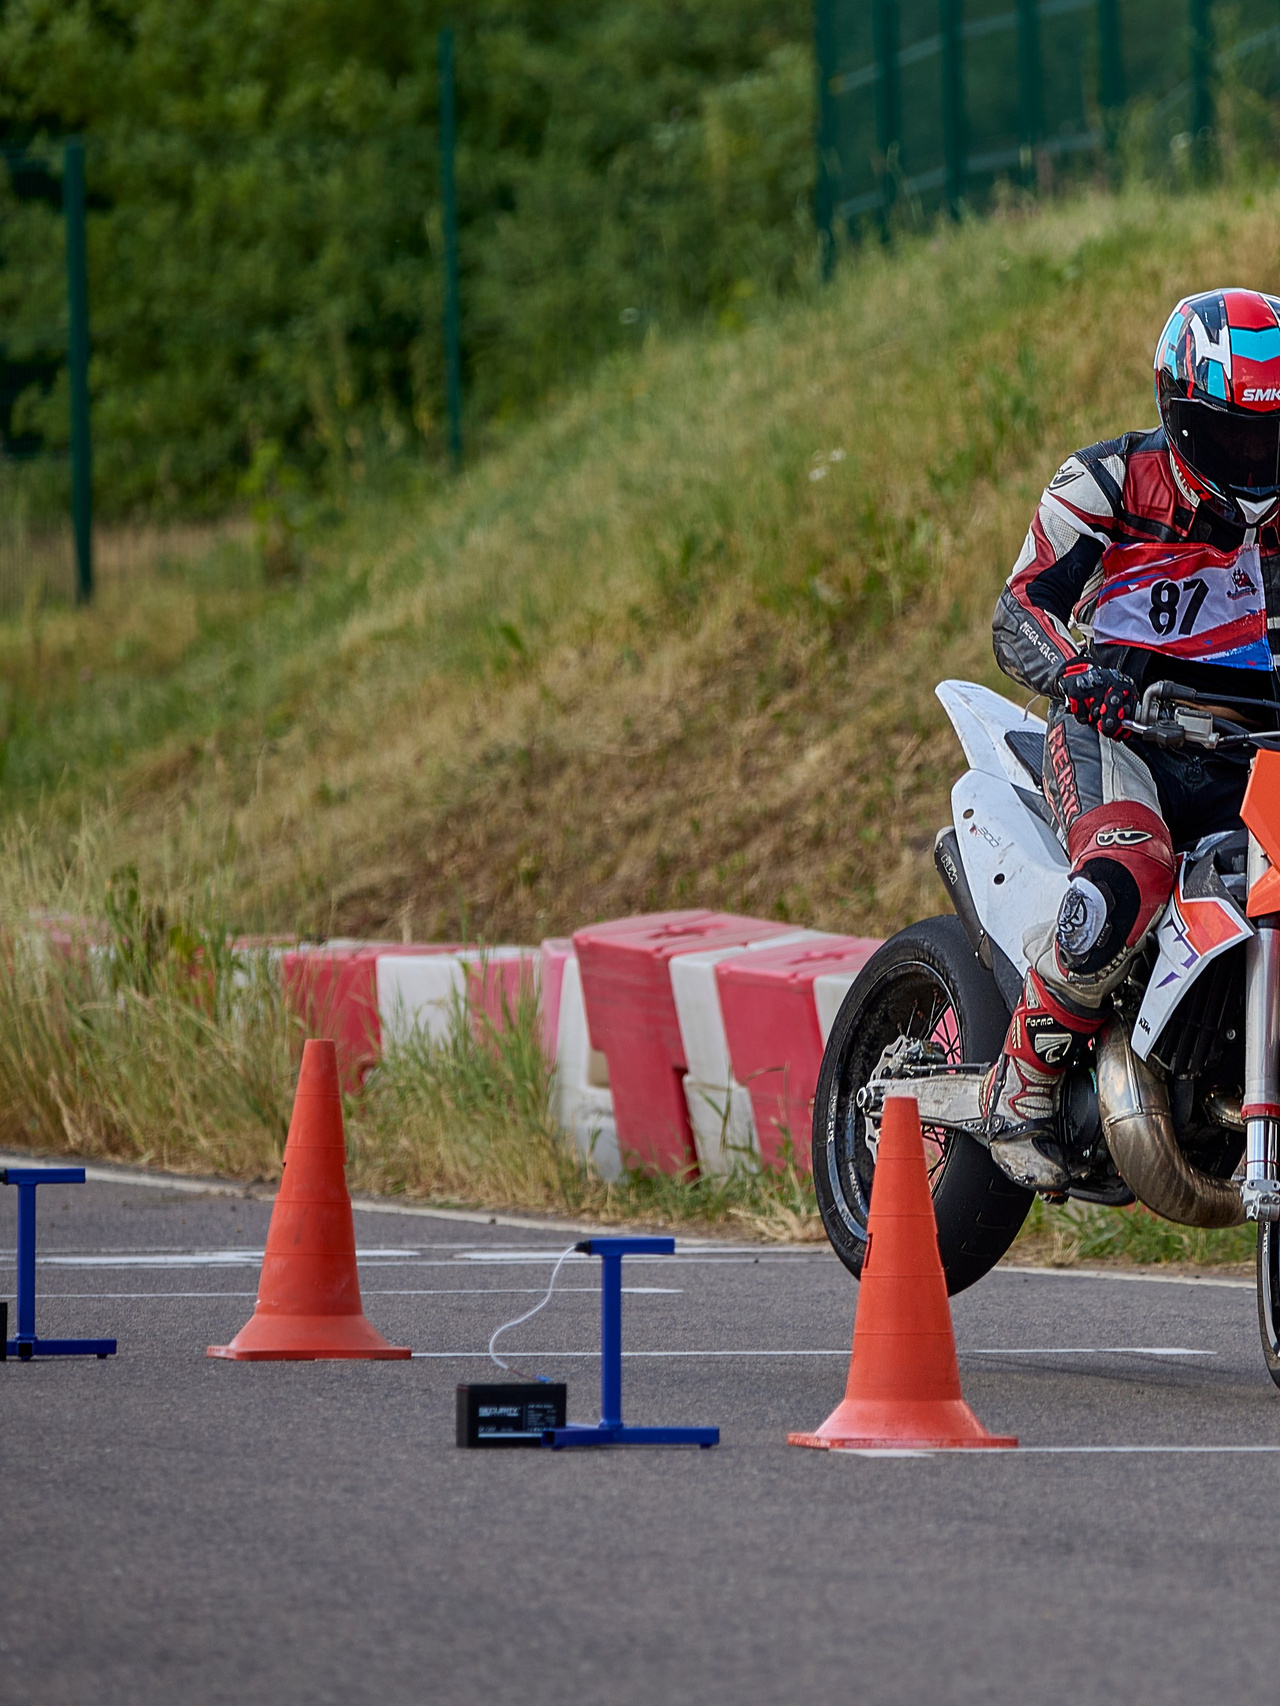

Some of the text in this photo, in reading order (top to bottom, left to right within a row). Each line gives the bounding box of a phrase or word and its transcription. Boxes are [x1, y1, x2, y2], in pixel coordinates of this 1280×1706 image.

[1148, 578, 1210, 637] 87
[1019, 620, 1059, 665] MEGA-RACE
[1138, 1016, 1151, 1036] KTM
